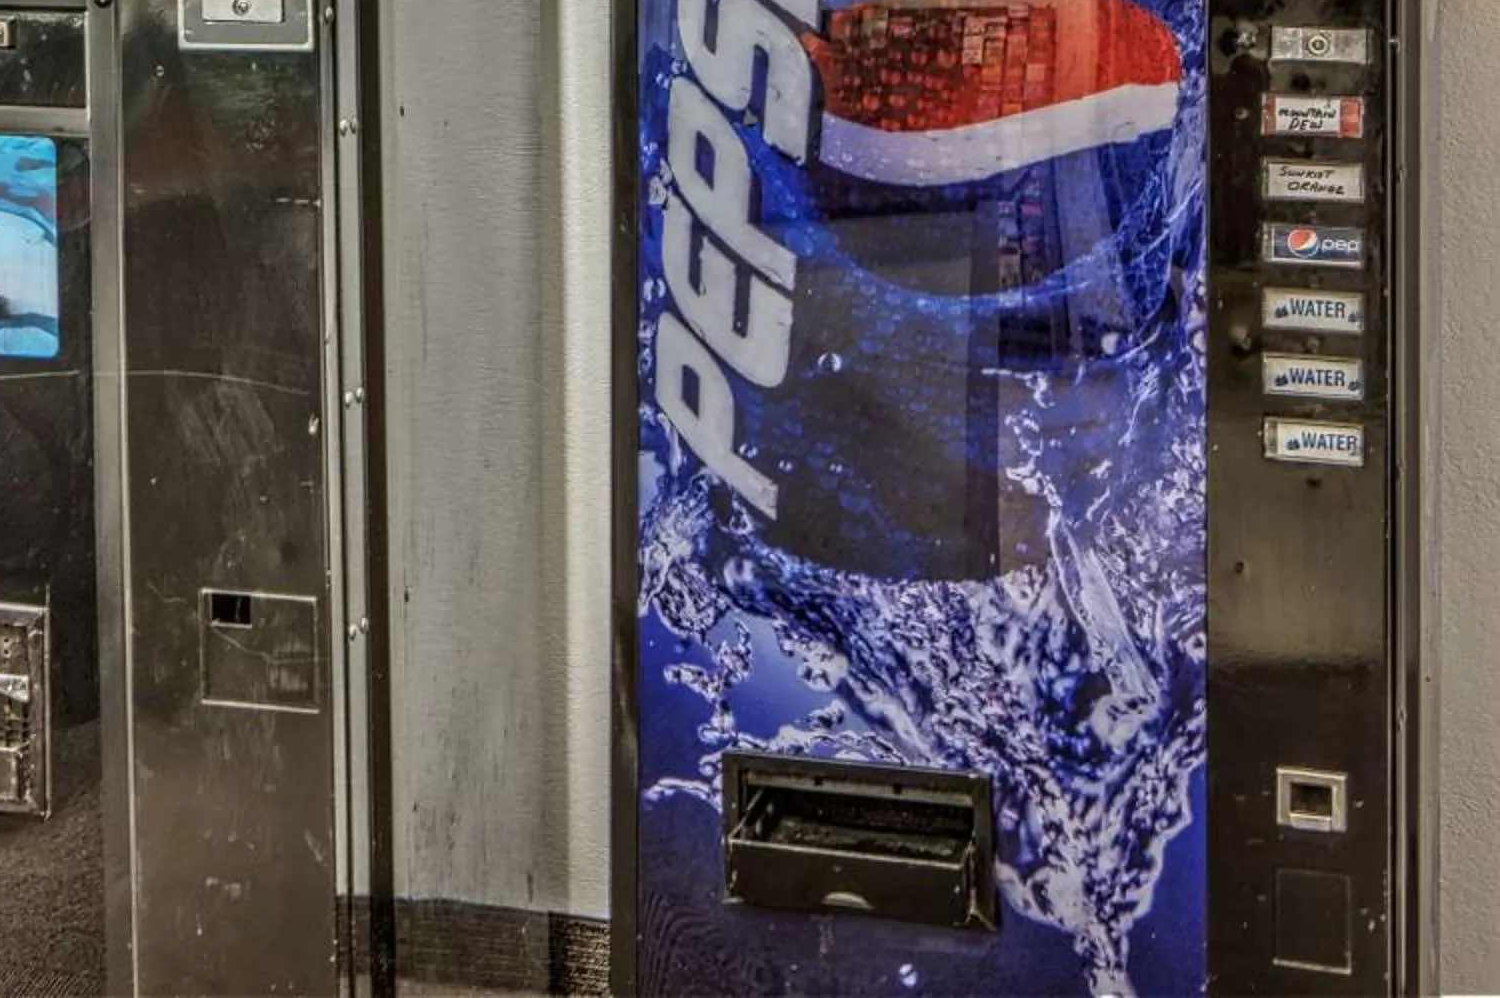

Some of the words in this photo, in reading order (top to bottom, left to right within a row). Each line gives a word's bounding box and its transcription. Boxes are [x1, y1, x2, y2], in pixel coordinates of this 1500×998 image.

[1288, 118, 1324, 131] DEW
[1286, 180, 1346, 195] ORANGE
[1289, 297, 1346, 319] WATER
[1289, 367, 1345, 387] WATER
[1300, 430, 1359, 451] WATER
